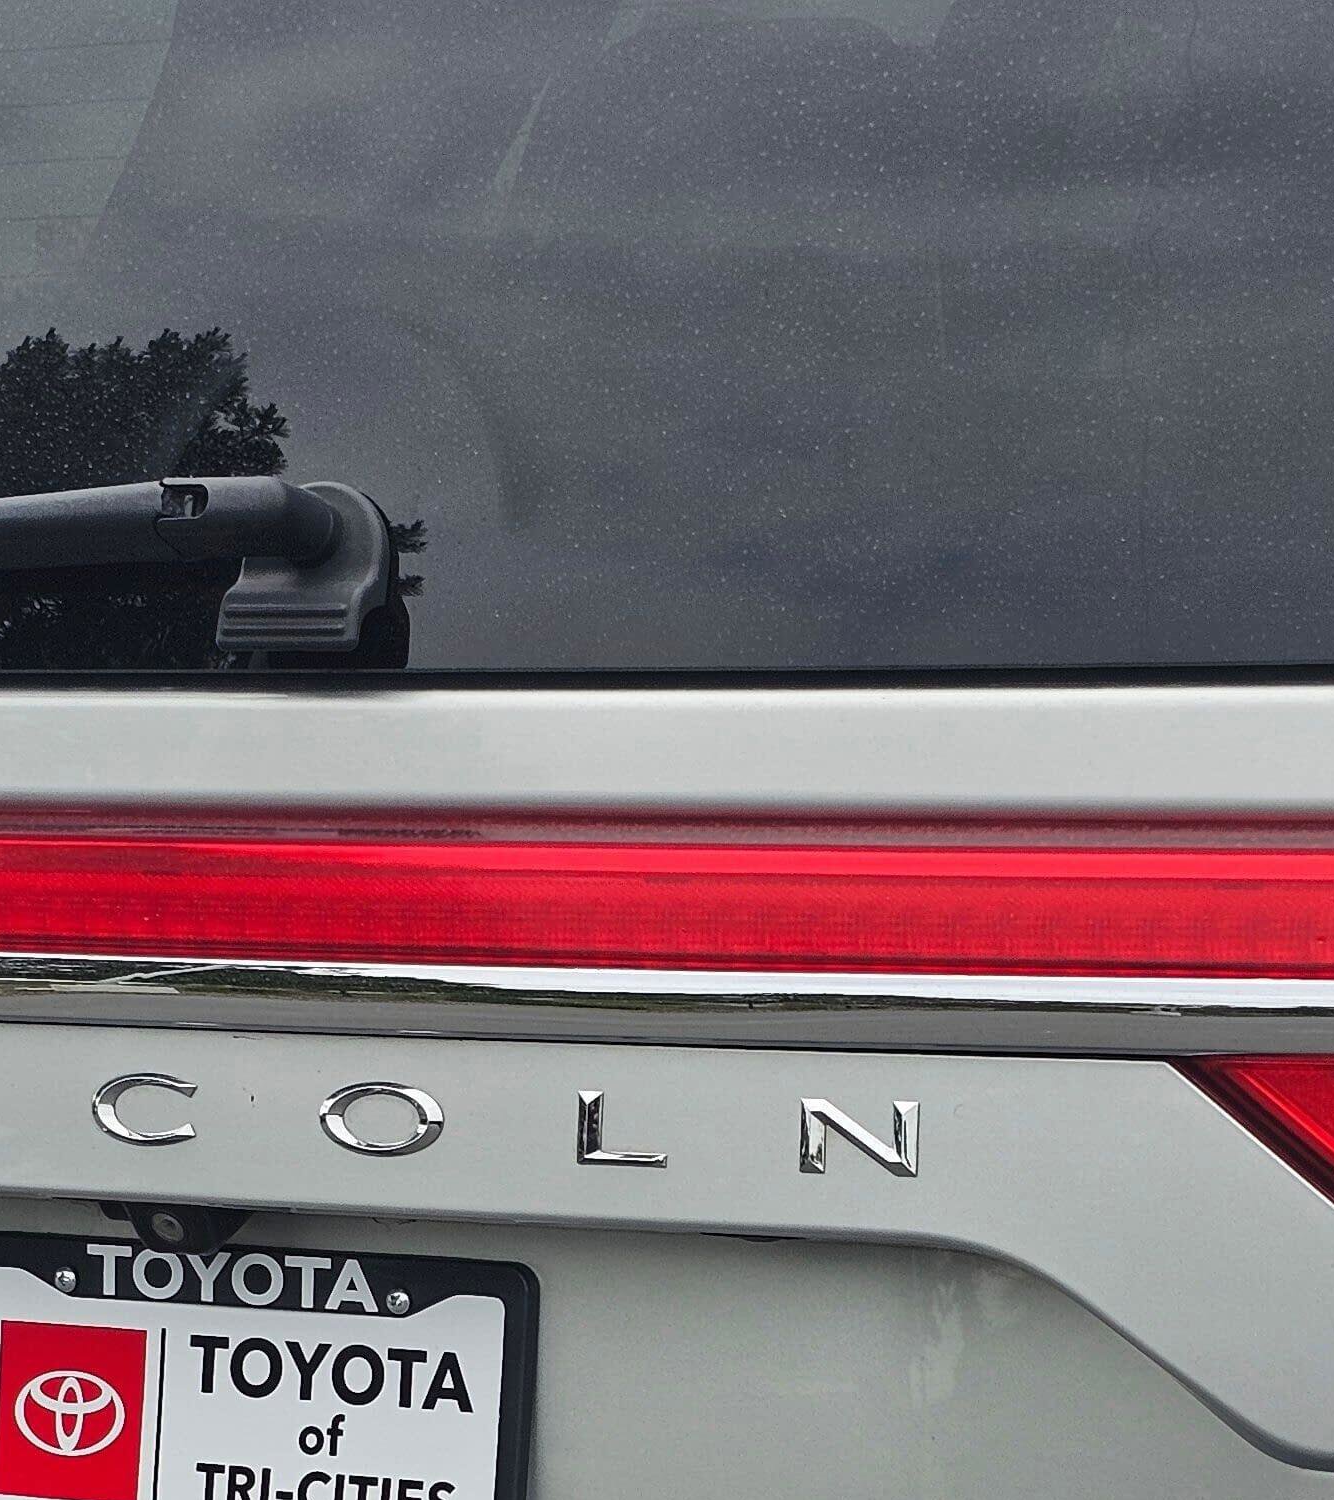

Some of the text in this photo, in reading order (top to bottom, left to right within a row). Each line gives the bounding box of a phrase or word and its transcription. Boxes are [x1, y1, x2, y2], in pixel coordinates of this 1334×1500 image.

[87, 1243, 379, 1313] TOYOTA
[190, 1335, 474, 1413] TOYOTA
[299, 1414, 346, 1457] of
